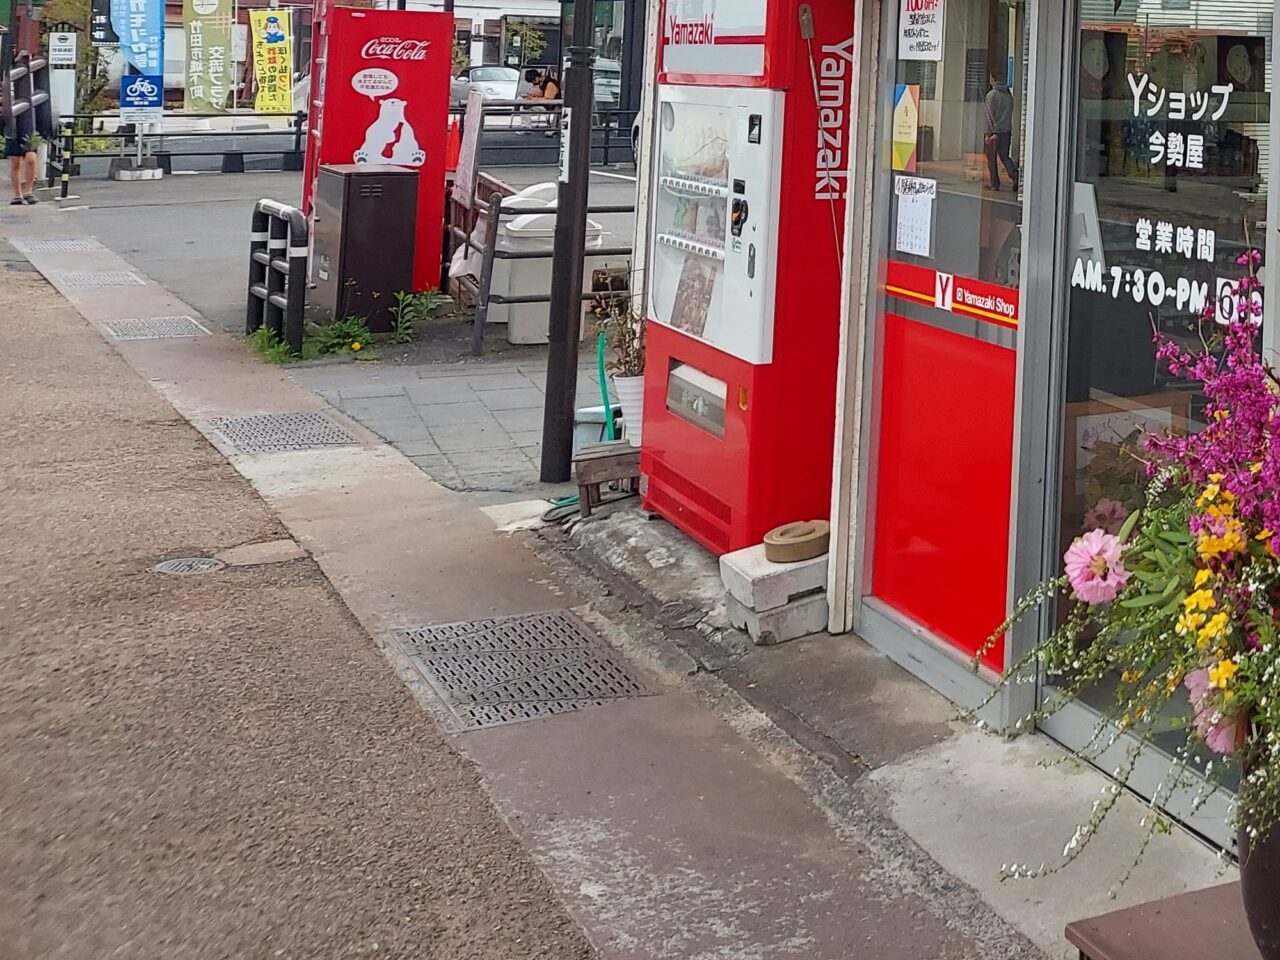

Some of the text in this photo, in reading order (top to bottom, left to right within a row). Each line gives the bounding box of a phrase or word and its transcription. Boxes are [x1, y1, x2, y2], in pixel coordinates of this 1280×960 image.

[669, 13, 715, 46] Yamazaki
[361, 39, 431, 60] Coca-Cola
[1126, 72, 1235, 122] Yショップ
[814, 36, 855, 201] Yamazaki
[1148, 130, 1205, 169] 今勢屋
[1135, 217, 1216, 263] 営業時間
[939, 274, 951, 307] Y
[963, 289, 1015, 317] Yamazaki Shop
